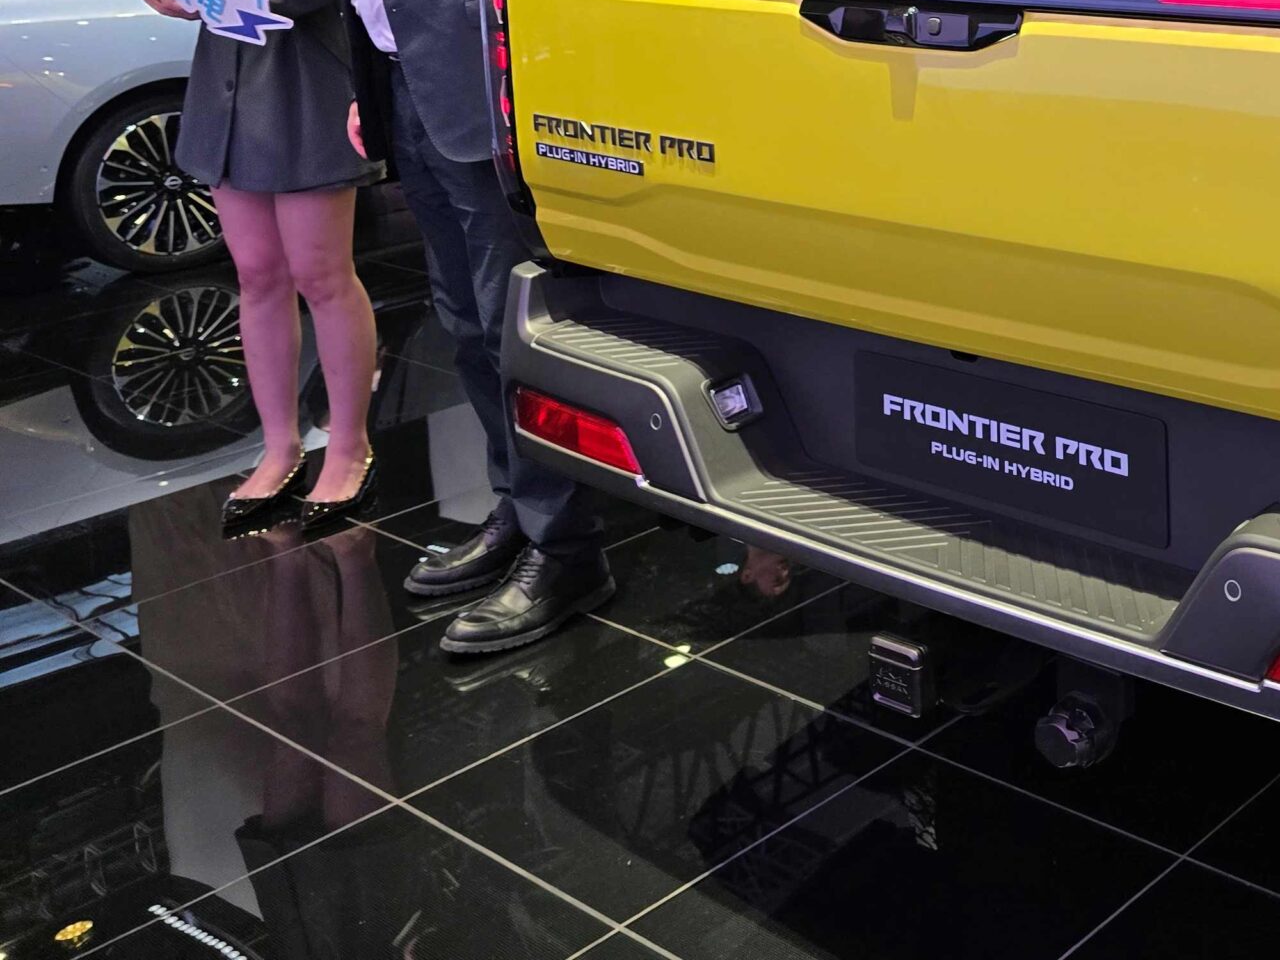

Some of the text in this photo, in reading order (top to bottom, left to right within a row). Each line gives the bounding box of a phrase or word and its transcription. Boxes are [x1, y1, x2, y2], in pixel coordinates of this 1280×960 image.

[533, 114, 715, 163] FRONTIER PRO
[538, 144, 640, 175] PLUG-IN HYBRID
[883, 393, 1129, 477] FRONTIER PRO
[930, 441, 1074, 491] PLUG-IN HYBRID
